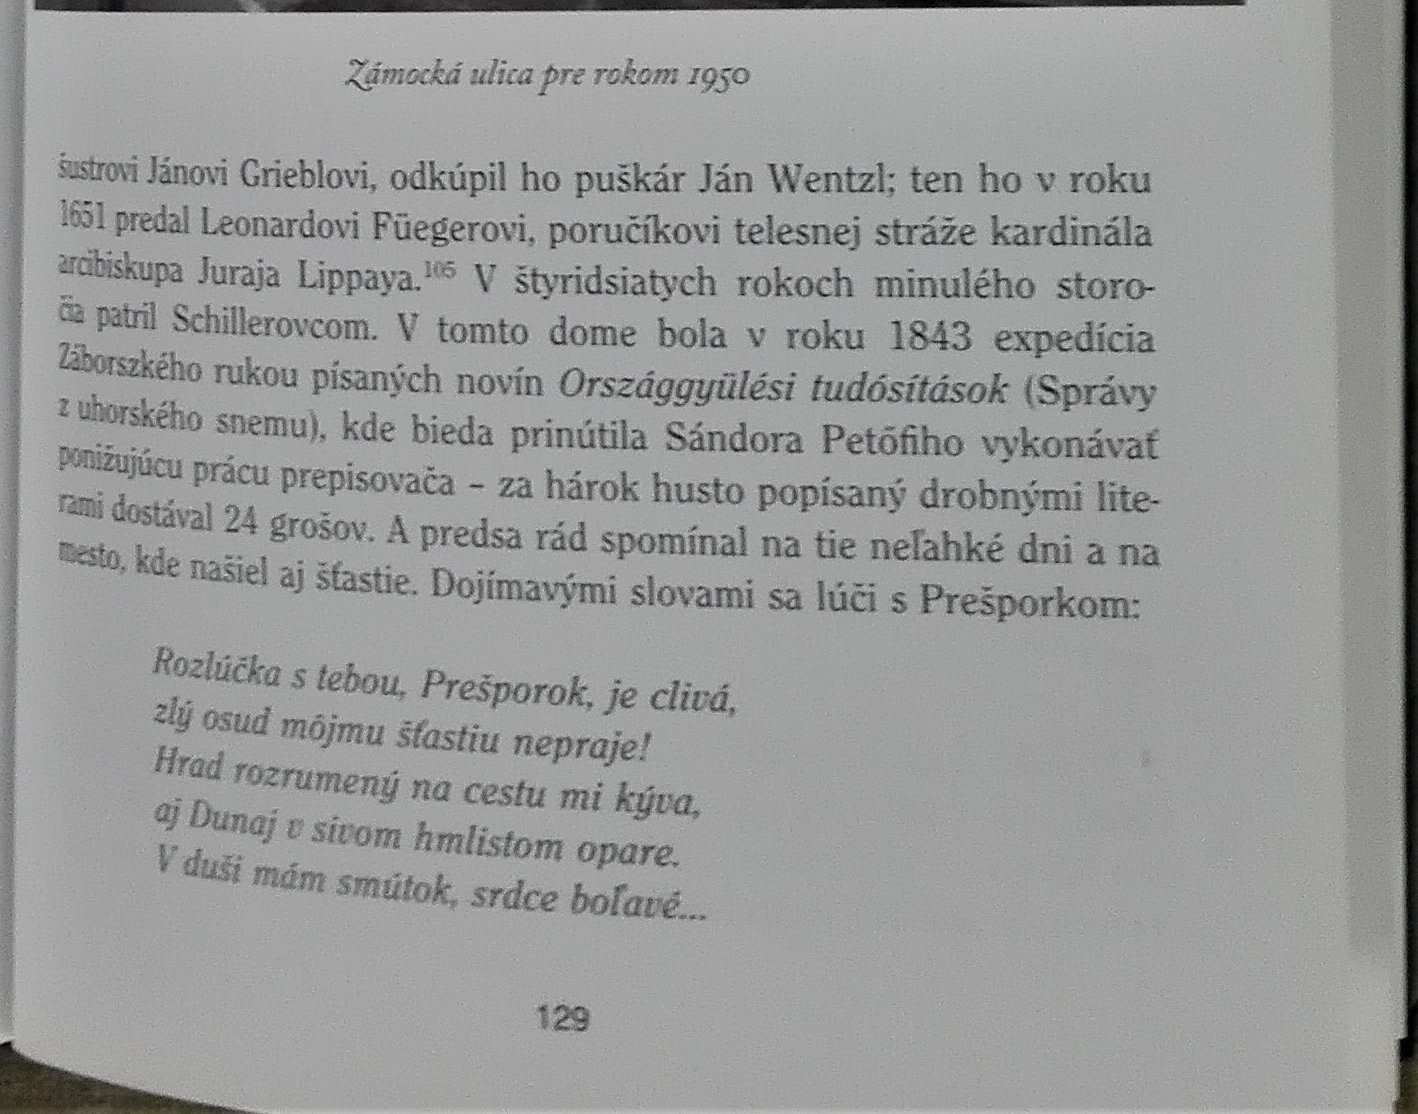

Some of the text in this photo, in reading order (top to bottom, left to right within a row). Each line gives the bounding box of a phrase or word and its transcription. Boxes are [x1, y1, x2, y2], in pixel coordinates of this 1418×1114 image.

[345, 58, 750, 97] Zámocká ulica pre rokom 1950
[60, 198, 1154, 252] 1651 predal Leonardovi Füegerovi, poručíkovi telesnej stráže kardinála
[58, 248, 184, 289] arcibiskupa
[197, 255, 281, 293] Juraja
[473, 263, 497, 294] V
[514, 264, 718, 303] štyridsiatych
[736, 265, 855, 299] rokoch
[874, 266, 1036, 300] minulého
[1056, 271, 1156, 301] storo-
[58, 443, 183, 481] ponižujúcu
[193, 455, 270, 488] prácu
[280, 461, 456, 497] prepisovača
[498, 476, 534, 500] za
[545, 468, 640, 503] hárok
[652, 471, 746, 505] husto
[757, 476, 907, 515] popísaný
[918, 477, 1083, 518] drobnými
[1097, 480, 1161, 514] lite-
[58, 541, 1140, 623] mesto, kde našiel aj šťastie. Dojímavými slovami sa lúči s Prešporkom:
[152, 646, 737, 718] Rozlúčka s tebou, Prešporok, je clivá,
[153, 696, 652, 768] zlý osud môjmu šťastiu nepraje!
[153, 745, 701, 822] Hrad rozrumený na cestu mi kýva,
[154, 797, 680, 871] aj Dunaj v sivom hmlistom opare.
[157, 842, 180, 873] V
[181, 846, 244, 884] duši
[251, 861, 327, 894] mám
[335, 871, 459, 909] smútok,
[469, 877, 561, 913] srdce
[536, 1003, 591, 1033] 129
